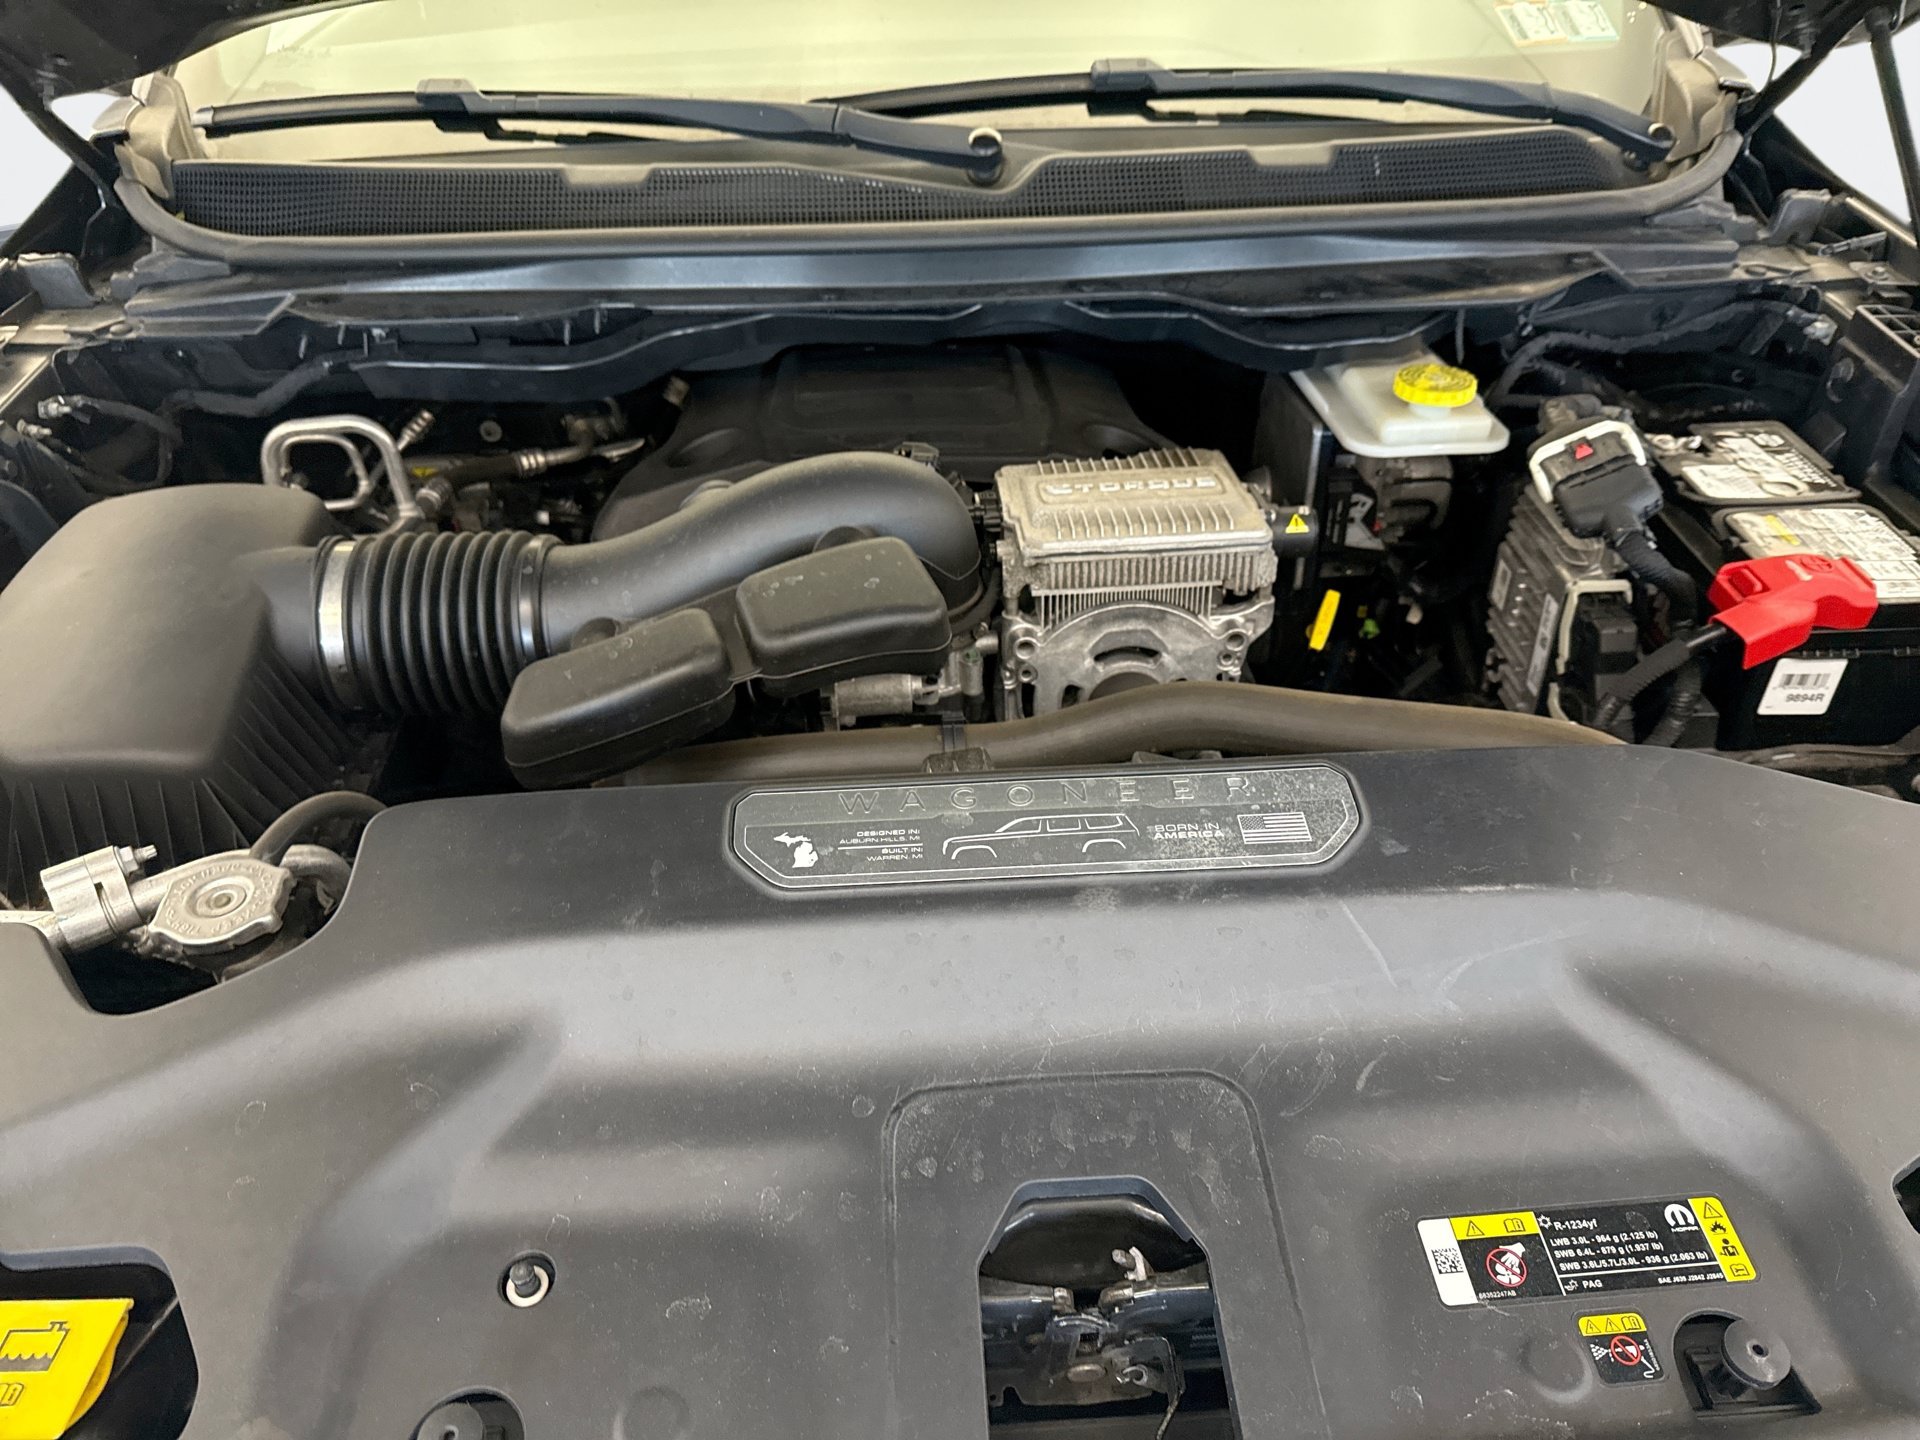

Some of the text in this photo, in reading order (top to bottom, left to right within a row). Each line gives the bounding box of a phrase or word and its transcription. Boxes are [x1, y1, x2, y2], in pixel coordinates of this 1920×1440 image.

[1785, 693, 1825, 703] 9894R
[838, 777, 1251, 814] WAGONEER
[1154, 822, 1220, 832] BORN IN
[856, 829, 906, 837] DESIGNED
[1153, 830, 1225, 840] AMERICA
[1553, 1219, 1598, 1231] R-1234yf
[1550, 1236, 1571, 1247] LWB
[1571, 1235, 1590, 1245] 3.0L
[1620, 1231, 1646, 1243] (2.125
[1646, 1230, 1659, 1240] lb)
[1553, 1249, 1576, 1259] SWB
[1651, 1242, 1664, 1251] lb)
[1558, 1261, 1581, 1272] SWB
[1696, 1251, 1709, 1261] lb)
[1582, 1279, 1603, 1289] PAG
